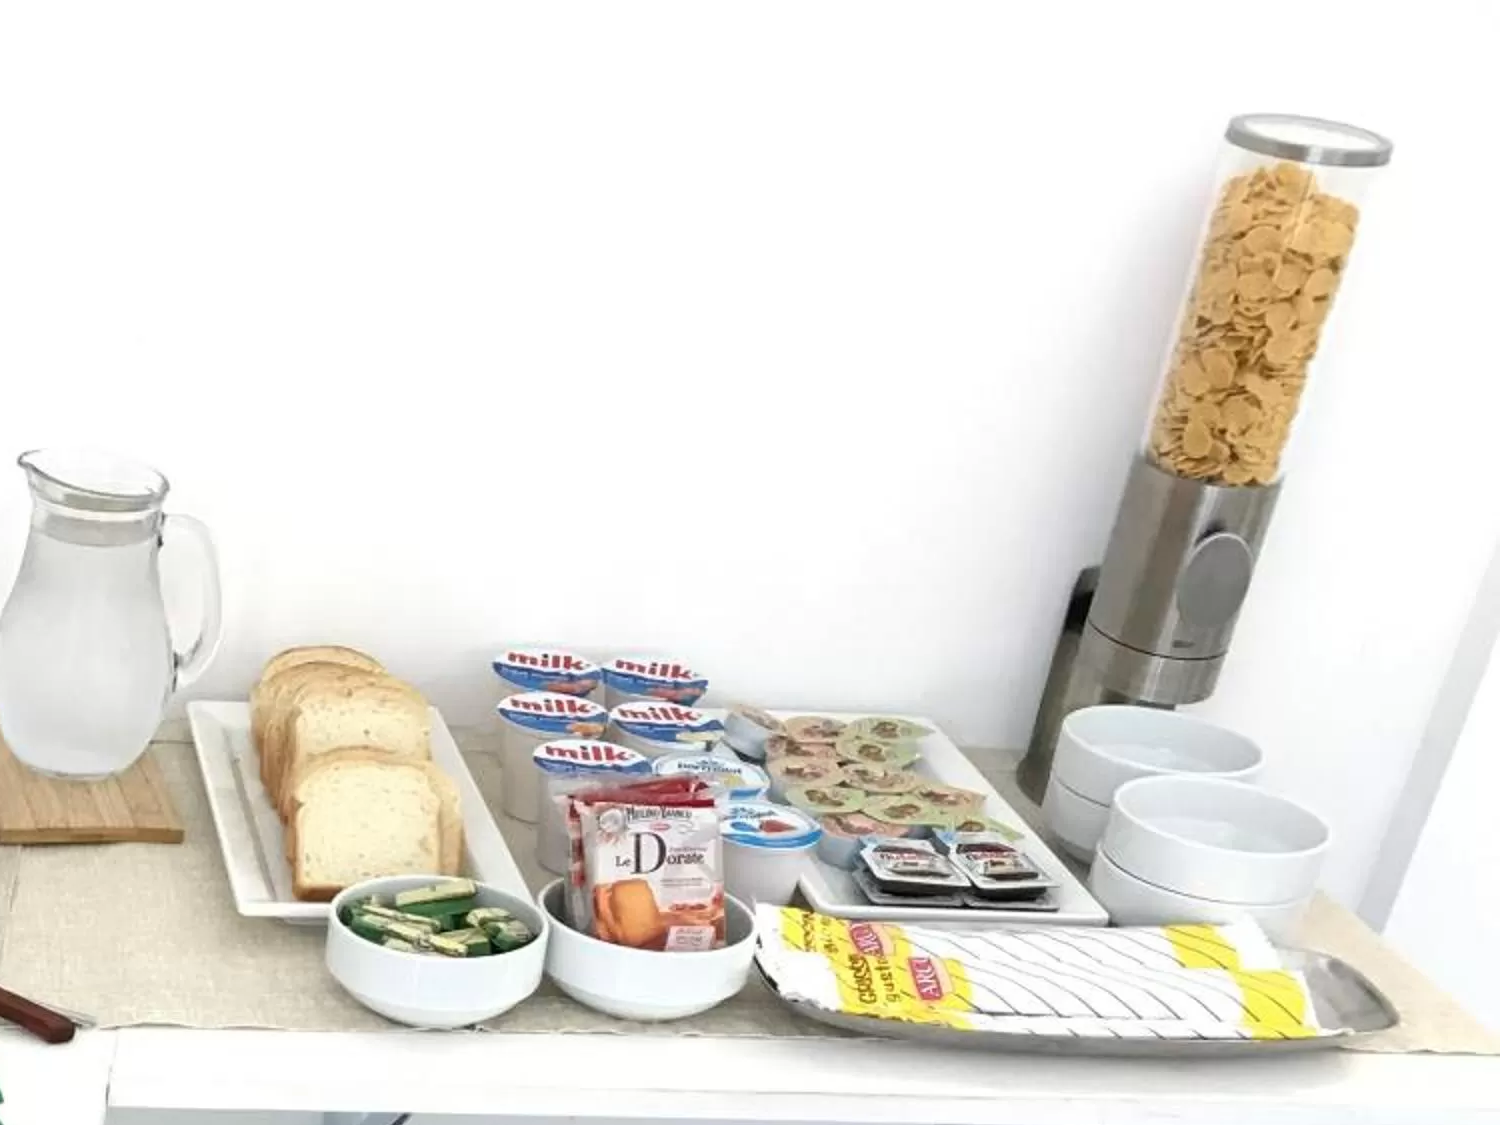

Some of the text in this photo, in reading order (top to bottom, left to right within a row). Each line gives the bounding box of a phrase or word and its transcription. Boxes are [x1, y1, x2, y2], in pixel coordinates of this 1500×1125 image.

[508, 652, 585, 671] milk
[615, 659, 693, 680] milk
[510, 698, 591, 713] milk
[618, 707, 699, 721] milk
[545, 745, 630, 761] milk
[615, 832, 705, 874] Le Dorate
